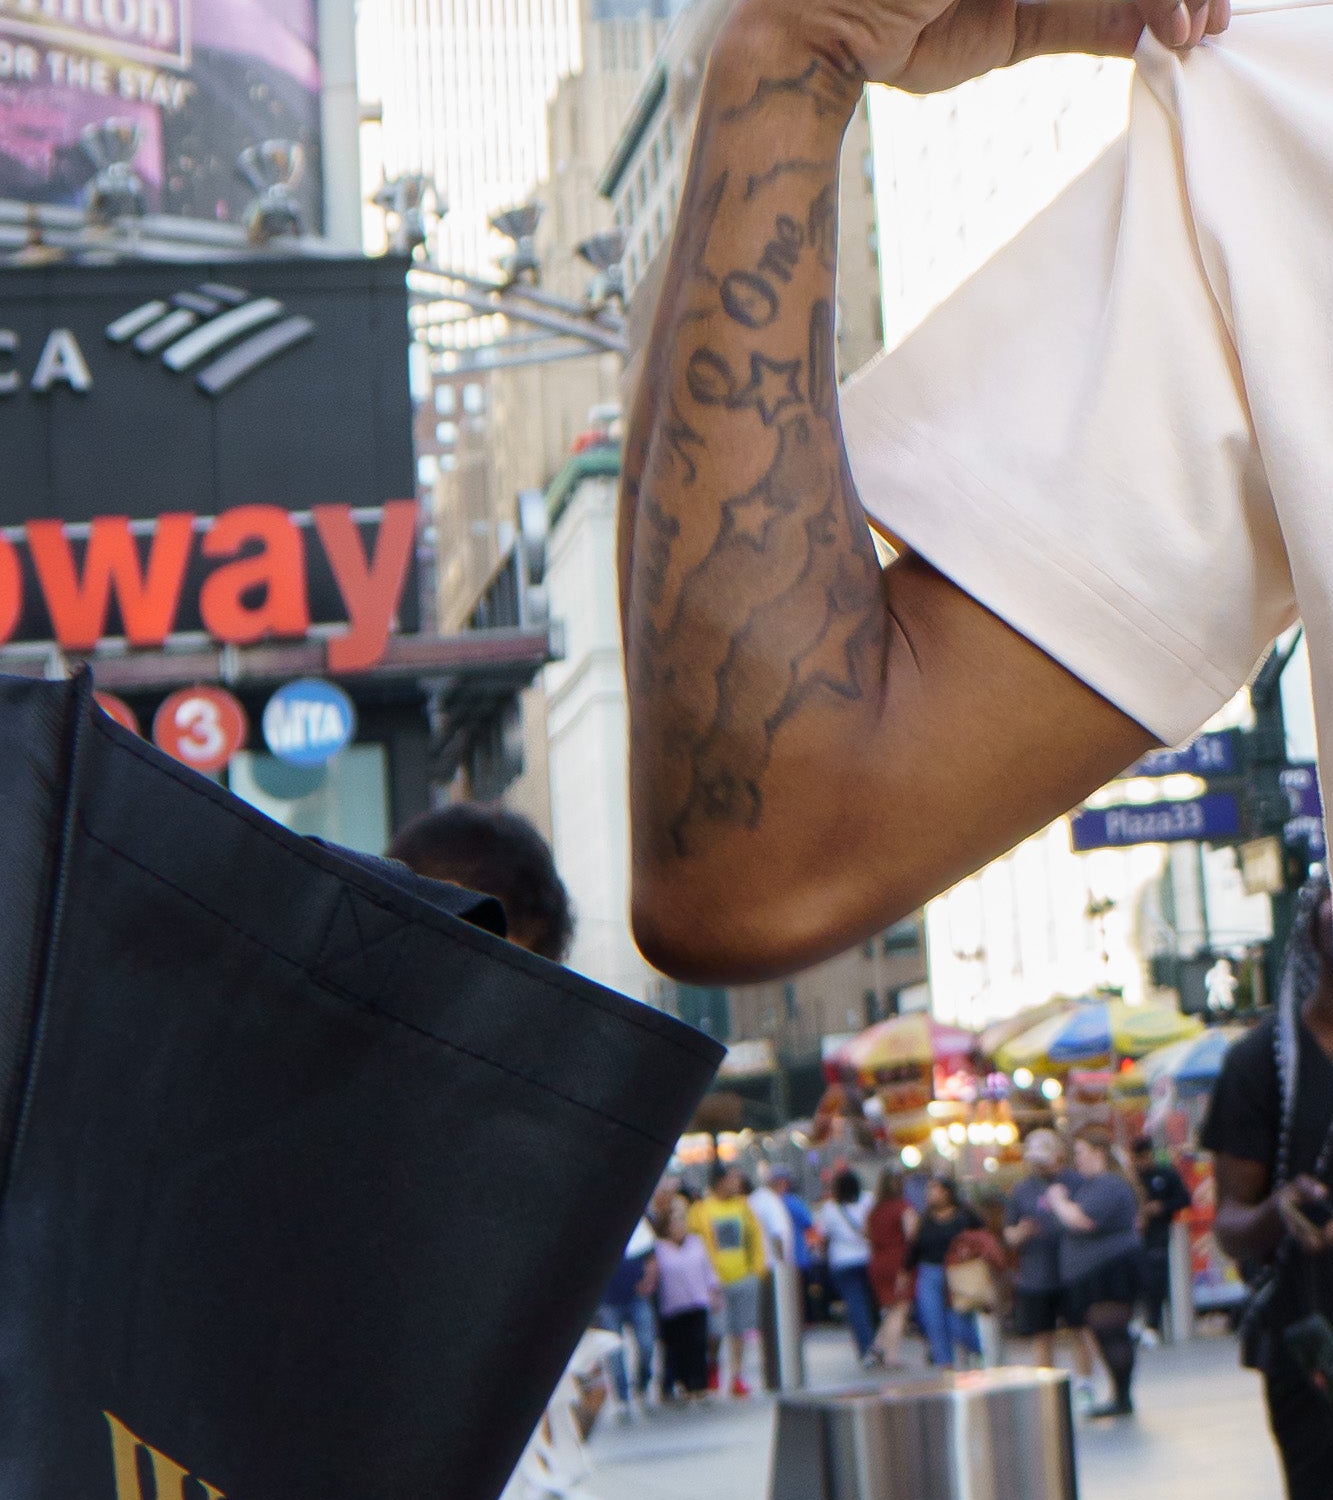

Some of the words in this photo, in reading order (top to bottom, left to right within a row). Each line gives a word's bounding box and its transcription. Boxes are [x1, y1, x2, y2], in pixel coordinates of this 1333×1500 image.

[48, 48, 113, 97] THE
[117, 65, 188, 110] STAY
[174, 698, 228, 760] 3
